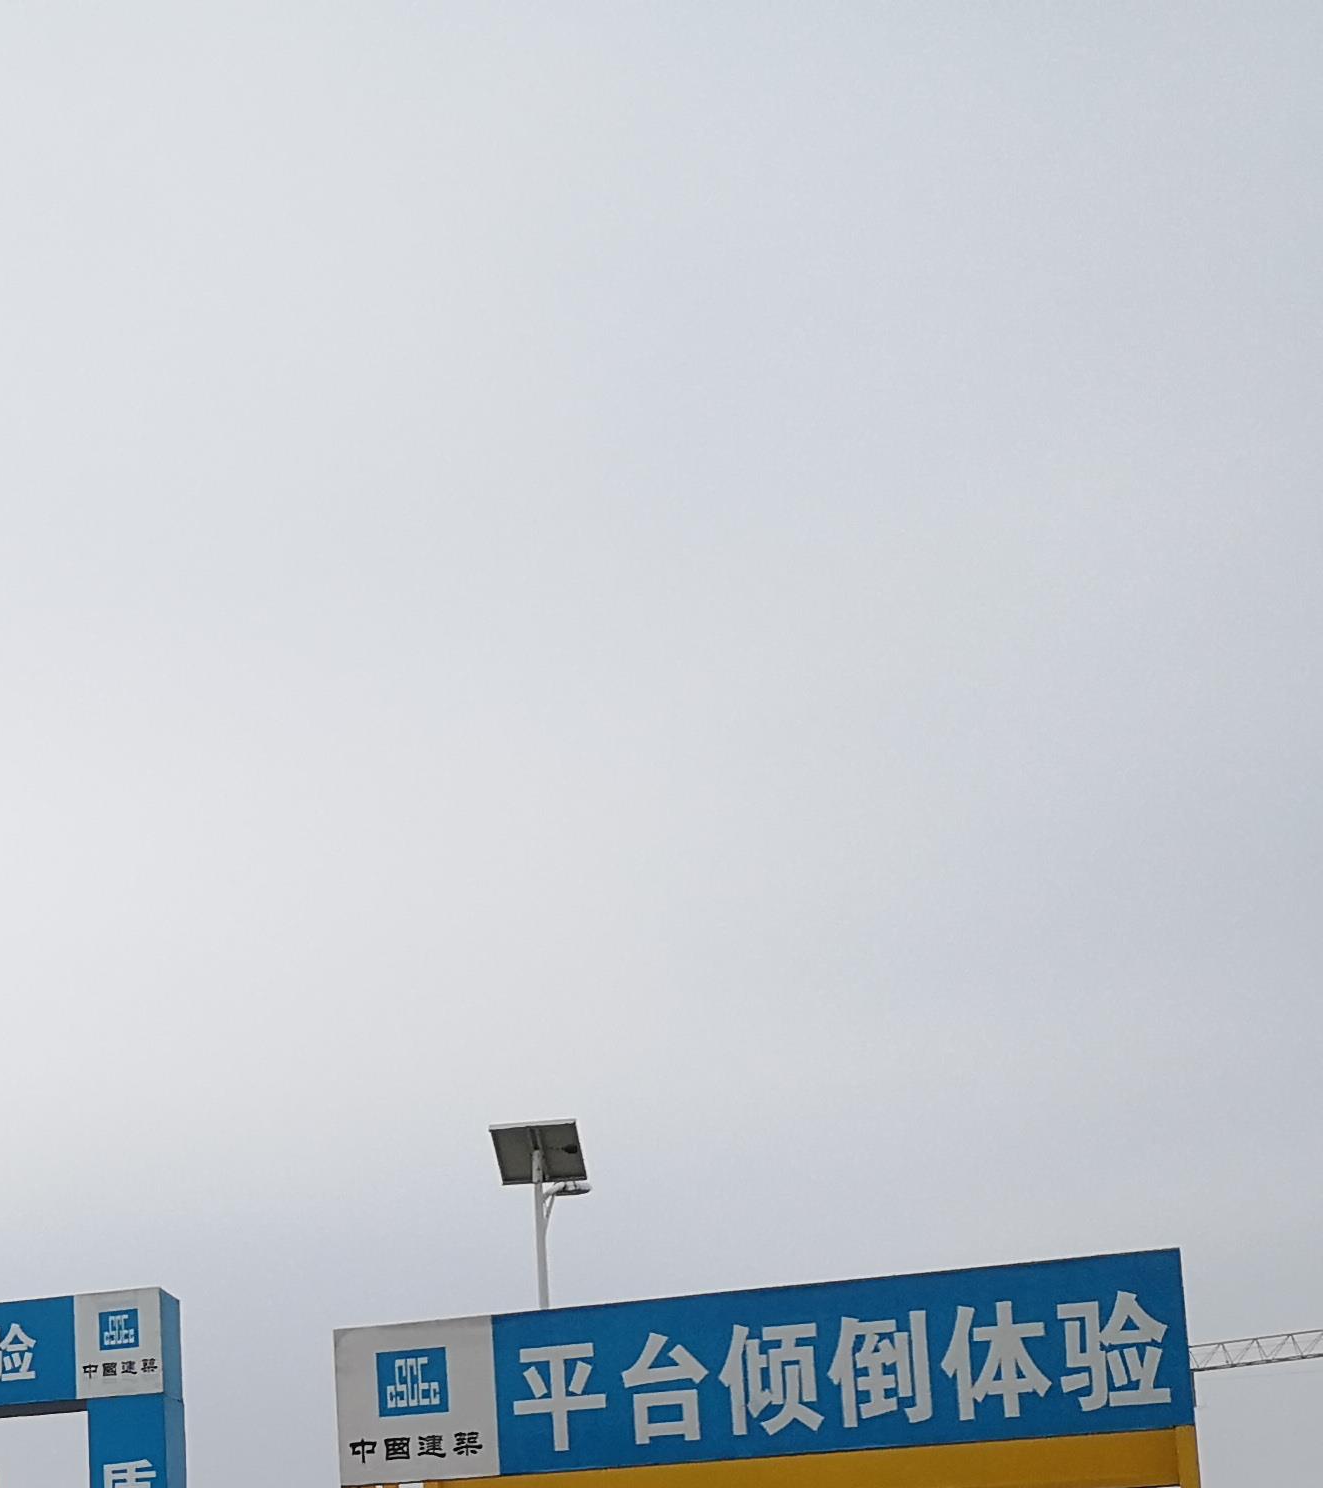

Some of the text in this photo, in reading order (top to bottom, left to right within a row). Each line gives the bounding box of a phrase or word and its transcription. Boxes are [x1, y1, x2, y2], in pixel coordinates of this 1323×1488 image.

[512, 1289, 1174, 1453] 平台倾倒体验
[349, 1430, 485, 1466] 中國建築
